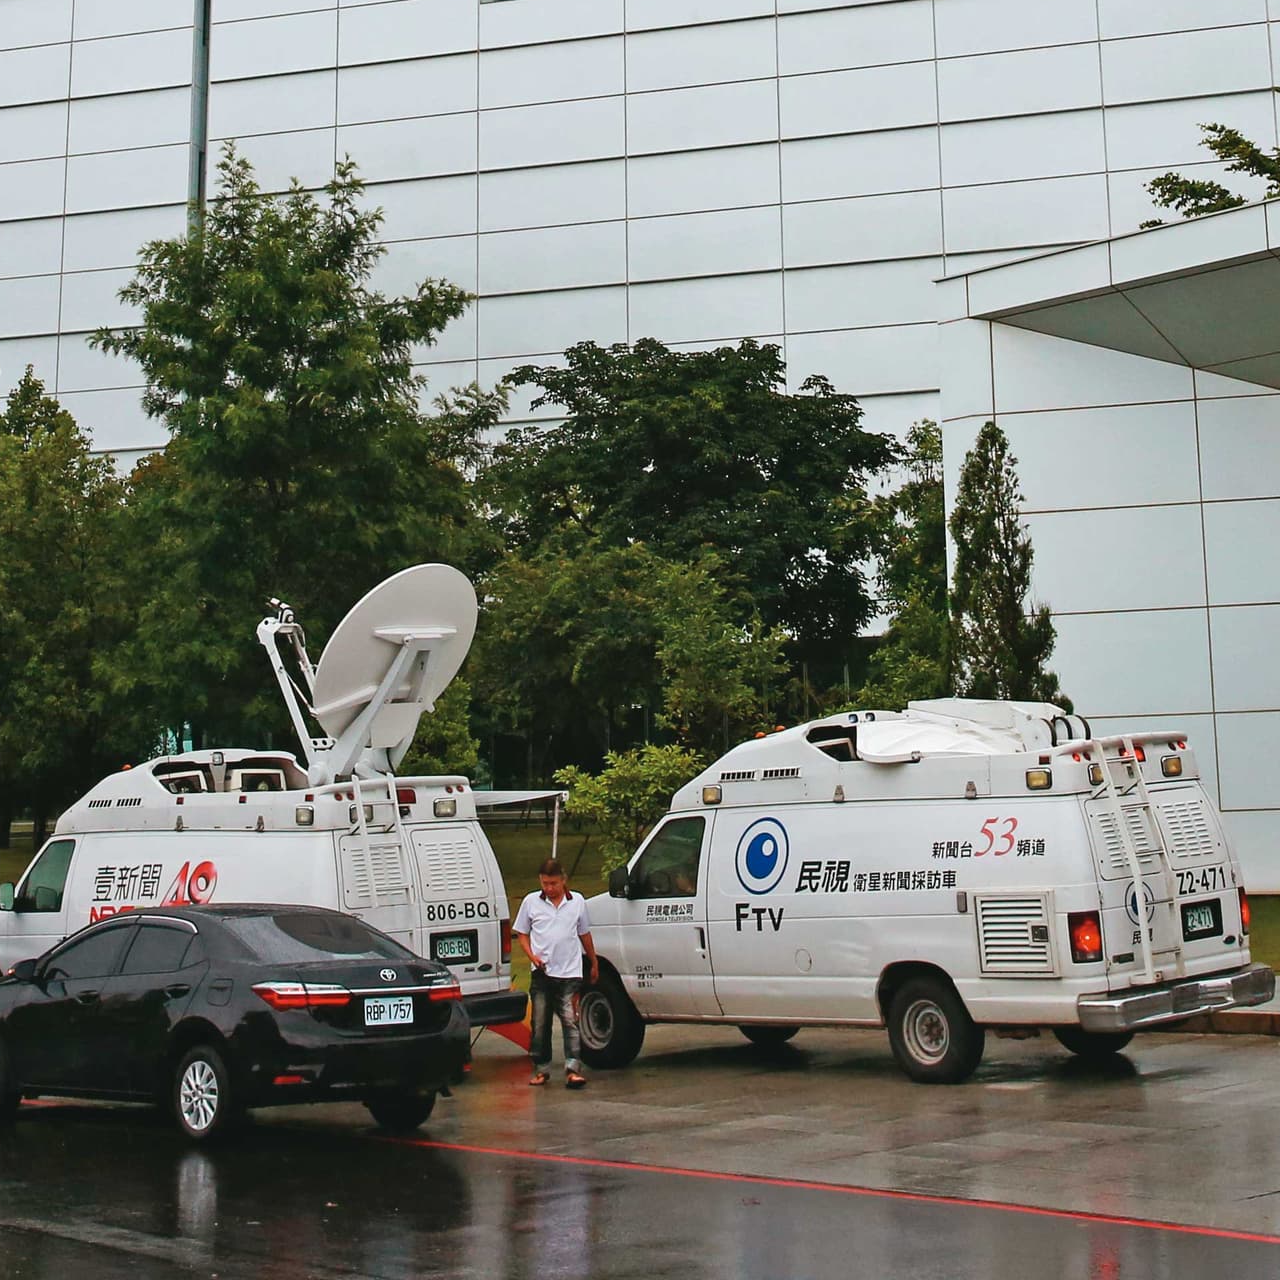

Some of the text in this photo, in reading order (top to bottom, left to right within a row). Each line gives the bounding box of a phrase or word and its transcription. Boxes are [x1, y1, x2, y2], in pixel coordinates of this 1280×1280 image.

[92, 864, 162, 902] 壹新聞
[795, 860, 956, 893] 民視 衛星新聞採訪車
[1176, 867, 1226, 895] Z2-471
[427, 902, 490, 921] 806-BQ
[735, 903, 784, 932] FTV
